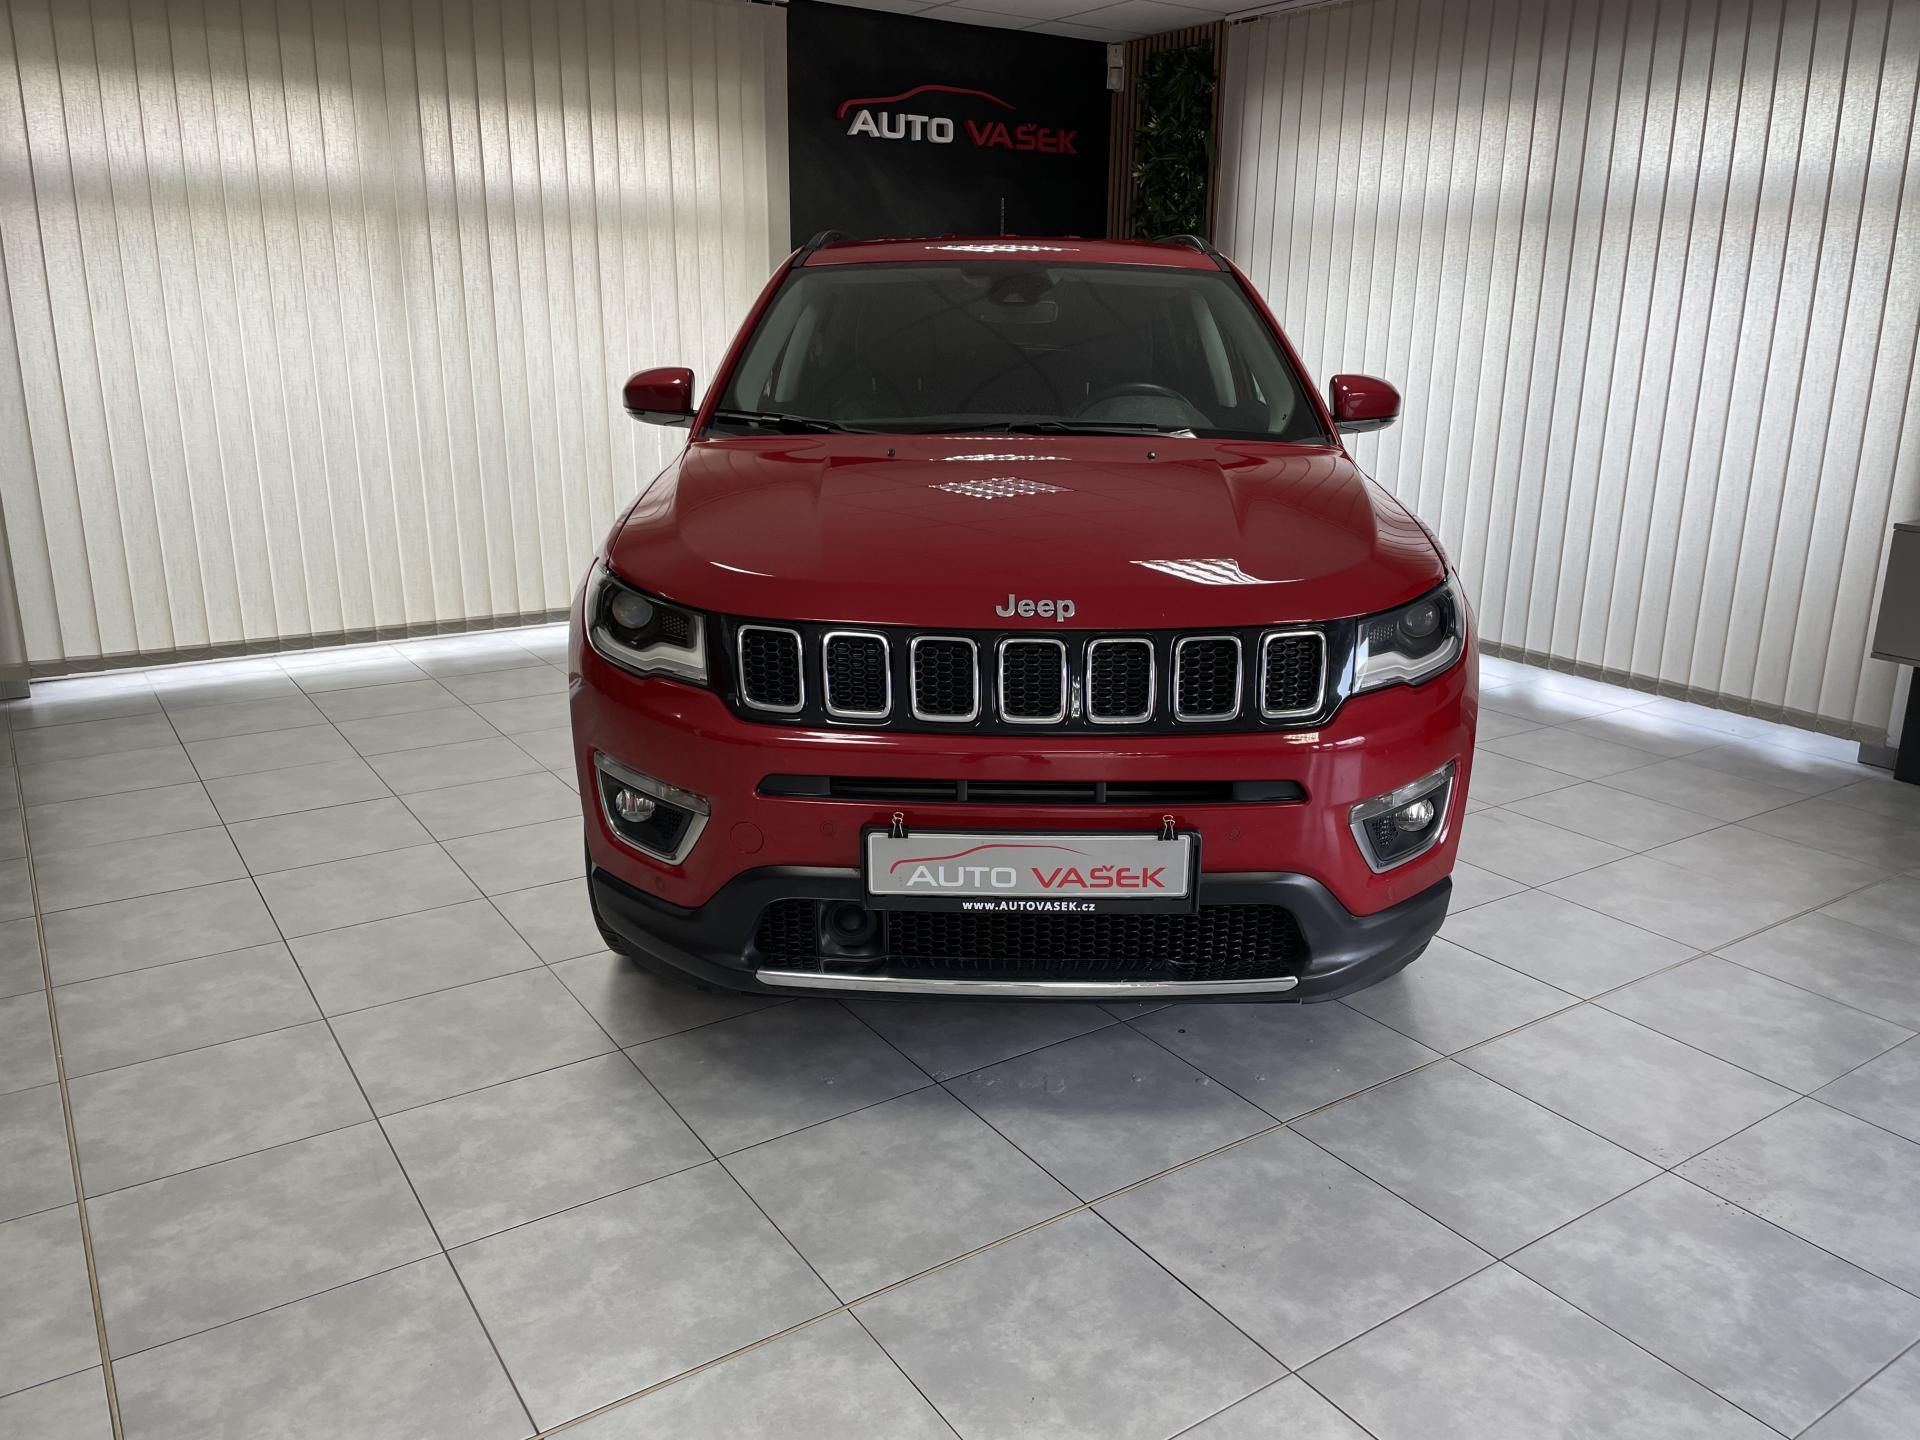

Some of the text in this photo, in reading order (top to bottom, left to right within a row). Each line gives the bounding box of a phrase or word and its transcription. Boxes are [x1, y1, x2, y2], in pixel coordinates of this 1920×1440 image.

[847, 109, 1078, 154] AUTO VAŠEK
[995, 593, 1075, 622] Jeep
[906, 865, 1165, 888] AUTO VAŠEK
[962, 901, 1096, 912] www.AUTOVASEK.cz
